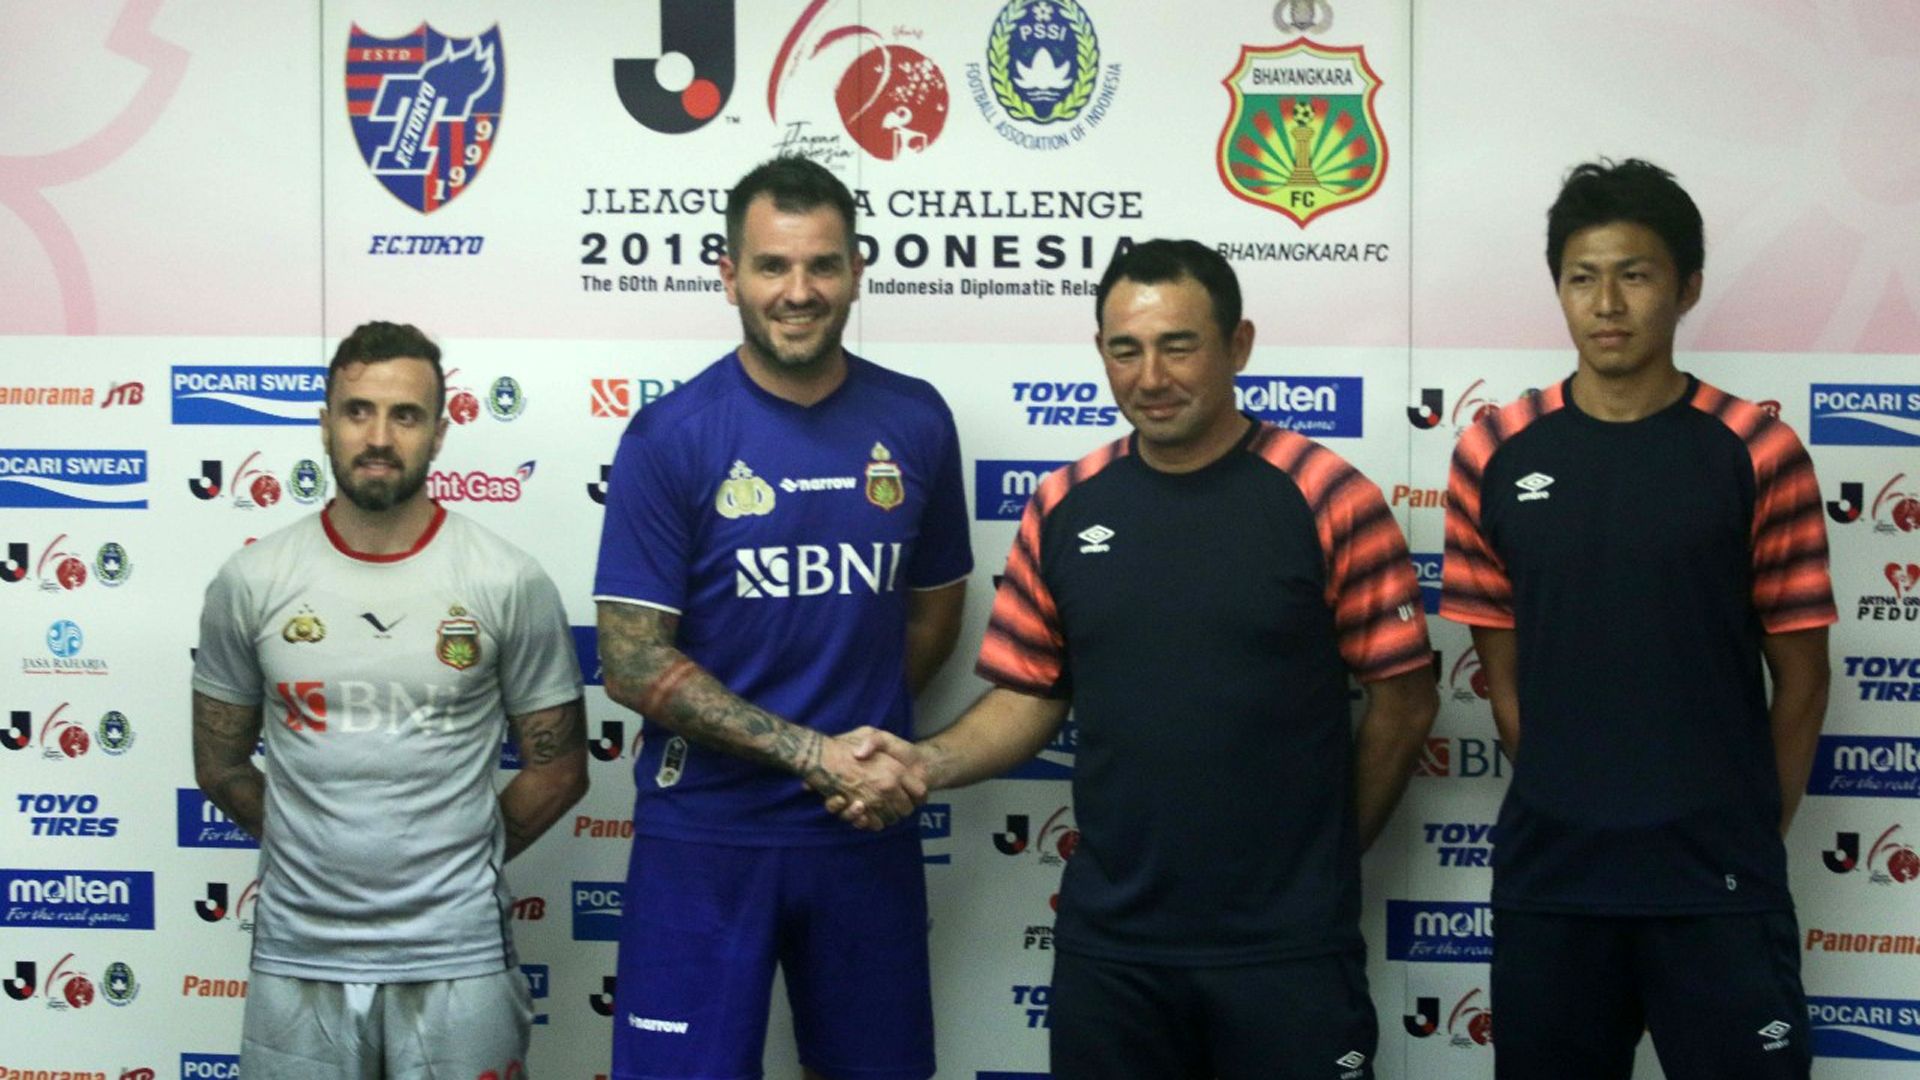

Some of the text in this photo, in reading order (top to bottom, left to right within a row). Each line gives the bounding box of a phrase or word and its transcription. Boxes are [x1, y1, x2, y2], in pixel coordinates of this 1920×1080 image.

[1019, 23, 1067, 41] PSSI
[362, 49, 411, 62] ESTD
[1252, 68, 1353, 86] BHAYANGKARA
[966, 62, 1121, 151] FOOTBALL ASSOCIATION OF INDONESIA
[581, 188, 729, 215] J.LEAGU
[888, 190, 1143, 218] CHALLENGE
[1291, 191, 1315, 208] FC
[580, 232, 1136, 269] 2018 DONESIA
[1217, 243, 1390, 262] BHAYANGKARA FC
[581, 275, 612, 292] The
[618, 275, 658, 292] 60th
[664, 275, 723, 293] Annive
[868, 278, 954, 296] Indonesia
[960, 277, 1055, 299] Diplomatic
[174, 373, 327, 392] POCARI SWEA
[1012, 382, 1098, 403] TOYO
[0, 382, 144, 409] anorama JTB
[1813, 391, 1902, 411] POCARI
[1026, 406, 1119, 427] TIRES
[0, 456, 144, 475] OCARI SWEAT
[464, 471, 521, 502] Gas
[796, 477, 857, 492] narrow
[796, 542, 902, 596] BNI
[1857, 606, 1918, 621] PEDU
[1858, 681, 1920, 702] TIRE
[338, 681, 458, 735] BNI
[1828, 775, 1853, 790] For
[1856, 775, 1879, 790] the
[17, 794, 99, 814] TOYO
[30, 817, 119, 838] TIRES
[573, 816, 634, 839] Pano
[1438, 847, 1492, 867] TIR
[9, 875, 130, 904] molten
[1725, 874, 1737, 891] 5
[575, 890, 621, 908] POC
[6, 907, 130, 926] For the real game
[1413, 907, 1494, 937] molt
[1409, 940, 1432, 956] For
[1436, 940, 1459, 956] the
[1012, 985, 1052, 1006] TO
[1806, 1003, 1893, 1026] POCARI
[634, 1016, 689, 1035] narrow
[184, 1061, 240, 1079] POCA
